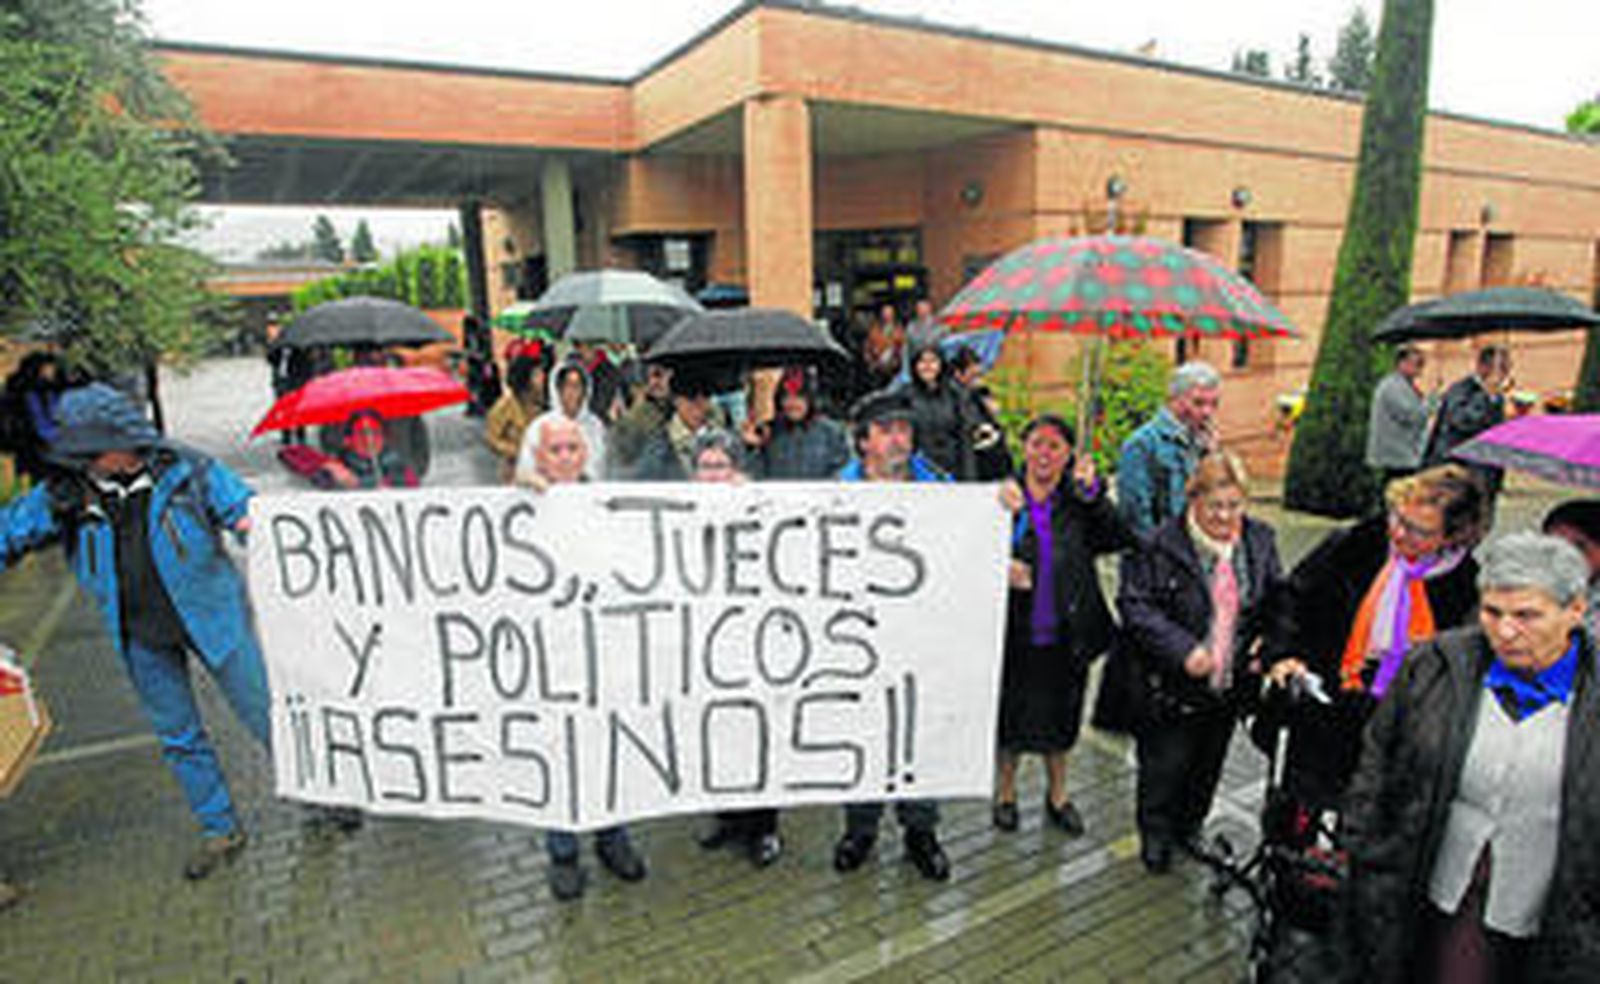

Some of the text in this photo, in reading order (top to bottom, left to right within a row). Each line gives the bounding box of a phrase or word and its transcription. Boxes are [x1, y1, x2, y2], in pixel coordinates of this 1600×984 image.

[271, 497, 927, 608] BANCOS, JUECES
[335, 584, 879, 708] Y POLÍTICOS
